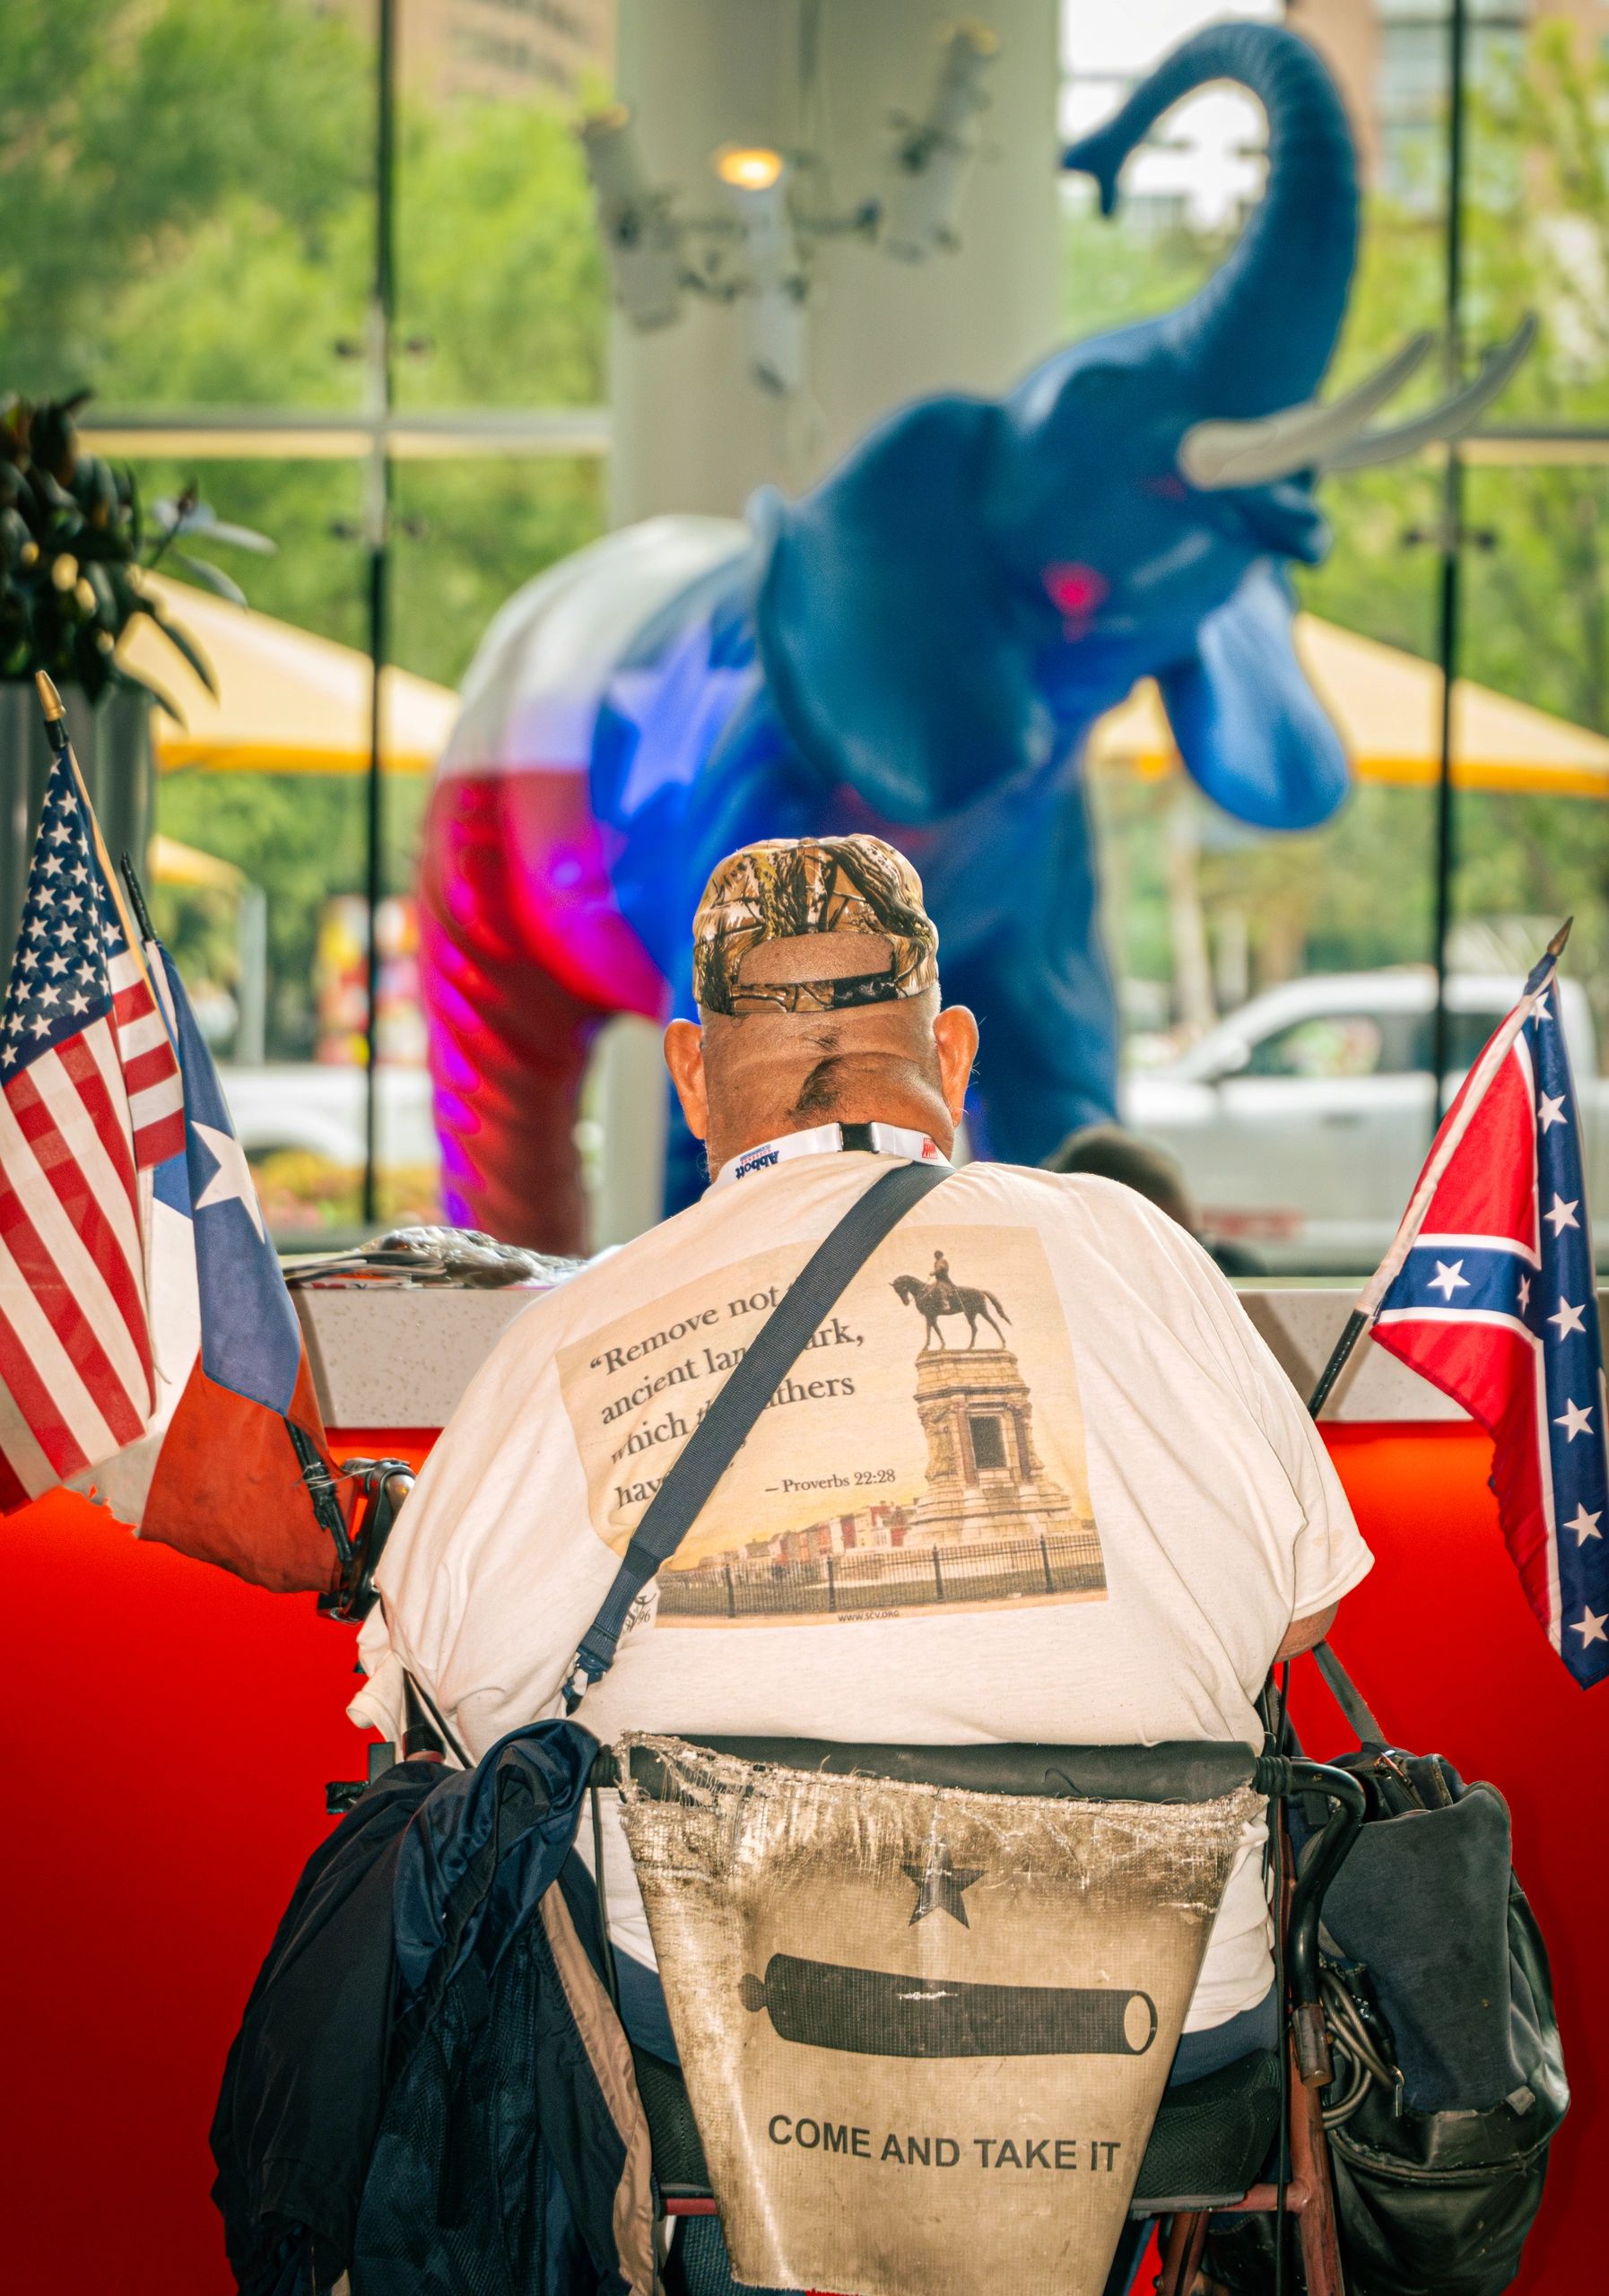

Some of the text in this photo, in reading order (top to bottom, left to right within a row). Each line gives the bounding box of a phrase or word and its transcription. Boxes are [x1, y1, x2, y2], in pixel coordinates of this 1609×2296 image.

[735, 1151, 779, 1180] Abbott
[727, 1286, 779, 1318] not
[601, 1358, 700, 1424] ancient
[702, 1318, 864, 1374] lanark,
[610, 1411, 689, 1465] which
[614, 1475, 665, 1510] hav
[782, 1474, 850, 1493] Proverbs
[853, 1468, 896, 1486] 22:28
[769, 2114, 1122, 2172] COME AND TAKE IT
